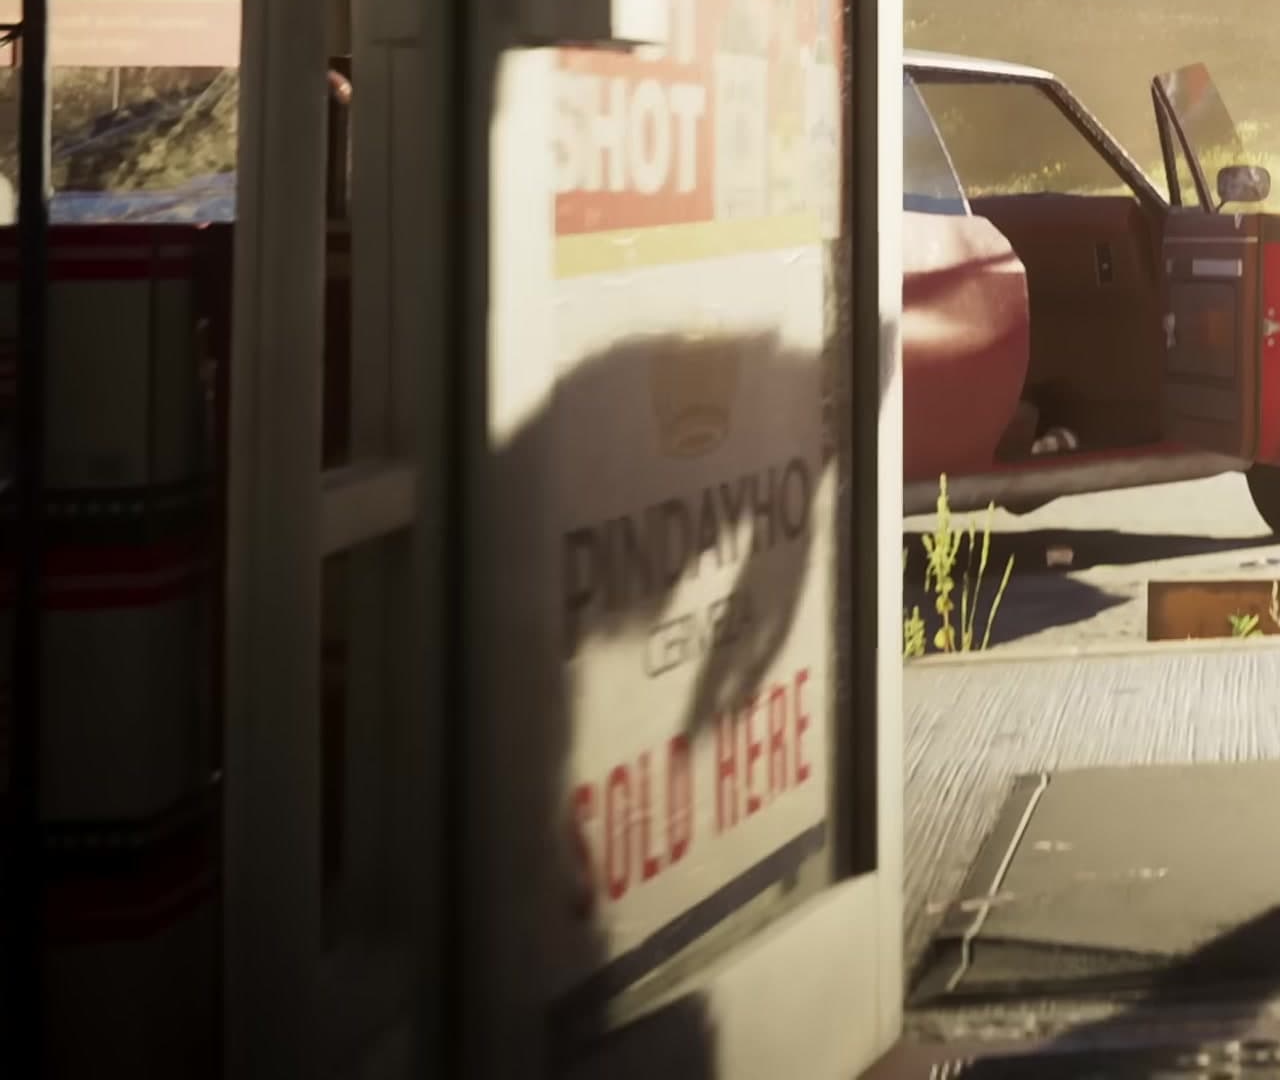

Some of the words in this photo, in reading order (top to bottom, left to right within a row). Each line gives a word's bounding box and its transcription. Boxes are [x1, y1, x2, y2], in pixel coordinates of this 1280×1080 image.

[553, 70, 706, 196] SHOT
[571, 732, 693, 921] SOLD
[713, 668, 810, 837] HERE
